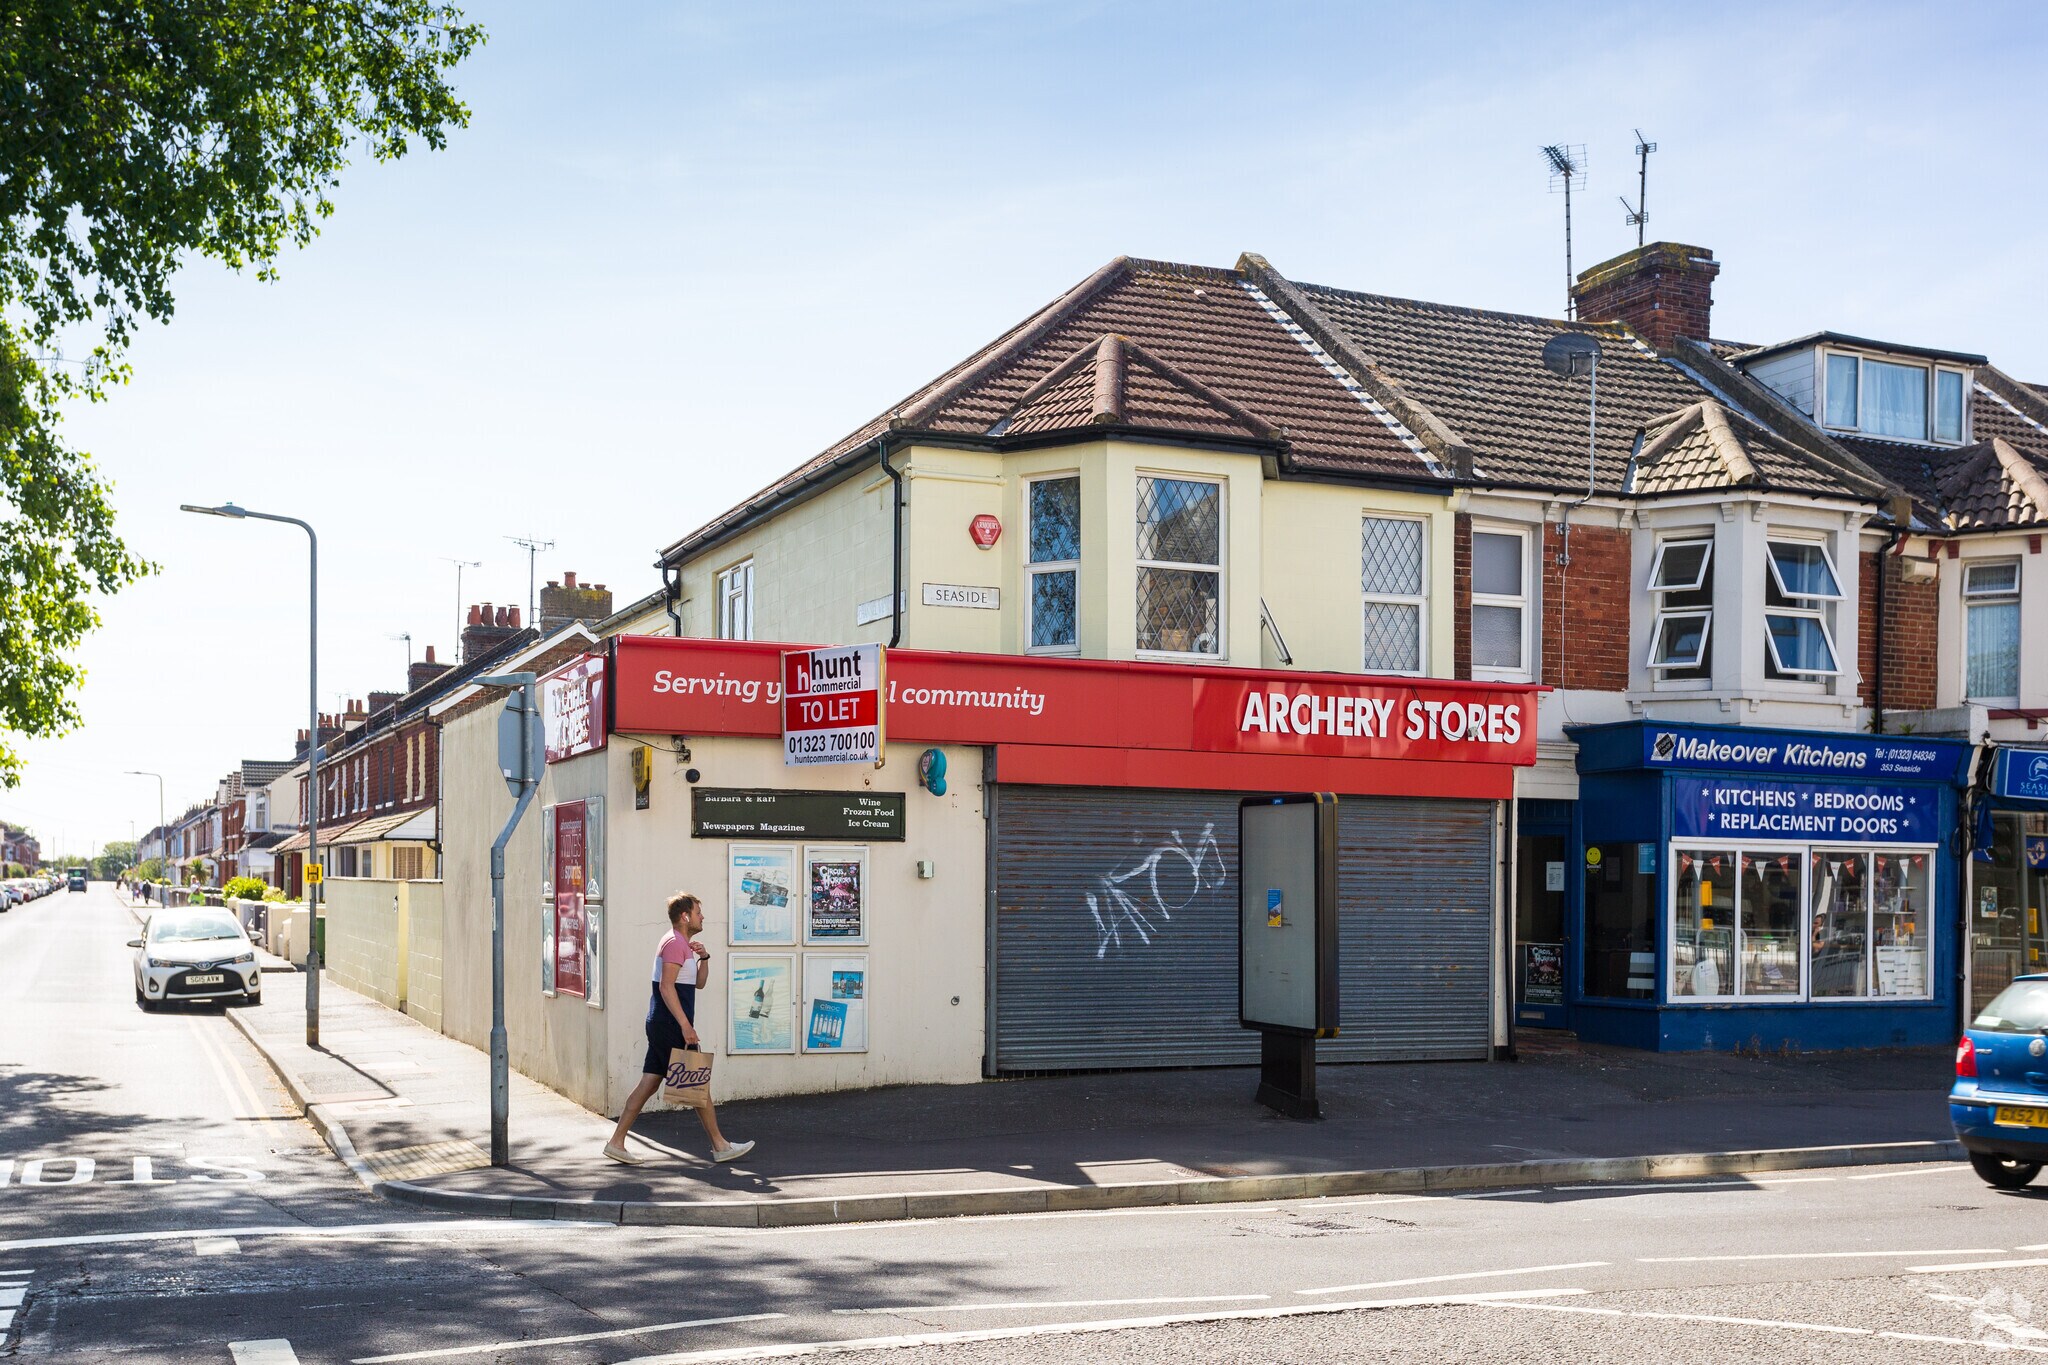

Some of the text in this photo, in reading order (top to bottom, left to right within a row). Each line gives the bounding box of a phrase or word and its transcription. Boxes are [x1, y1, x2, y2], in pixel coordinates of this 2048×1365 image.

[936, 590, 988, 604] SEASIDE
[811, 650, 861, 680] hunt
[653, 670, 760, 703] Serving
[812, 677, 861, 693] commercial
[800, 698, 860, 722] TO LET
[902, 686, 1044, 716] community
[1241, 692, 1521, 744] ARCHERY STORES
[789, 732, 874, 753] 01323 700100
[1676, 738, 1867, 768] Makeover Kitchens
[794, 752, 868, 764] huntcommercial.co.uk
[1888, 749, 1912, 762] (01323)
[1894, 764, 1921, 772] Seaside
[2020, 782, 2048, 792] SEASI
[859, 798, 881, 806] Wine
[1715, 789, 1904, 812] KITCHENS BEDROOMS
[843, 808, 894, 816] Frozen Food
[702, 822, 804, 832] Newspapers Magazines
[862, 820, 890, 828] Cream
[1721, 813, 1898, 834] REPLACEMENT DOORS
[666, 1062, 712, 1089] Boots
[0, 1156, 266, 1188] STO
